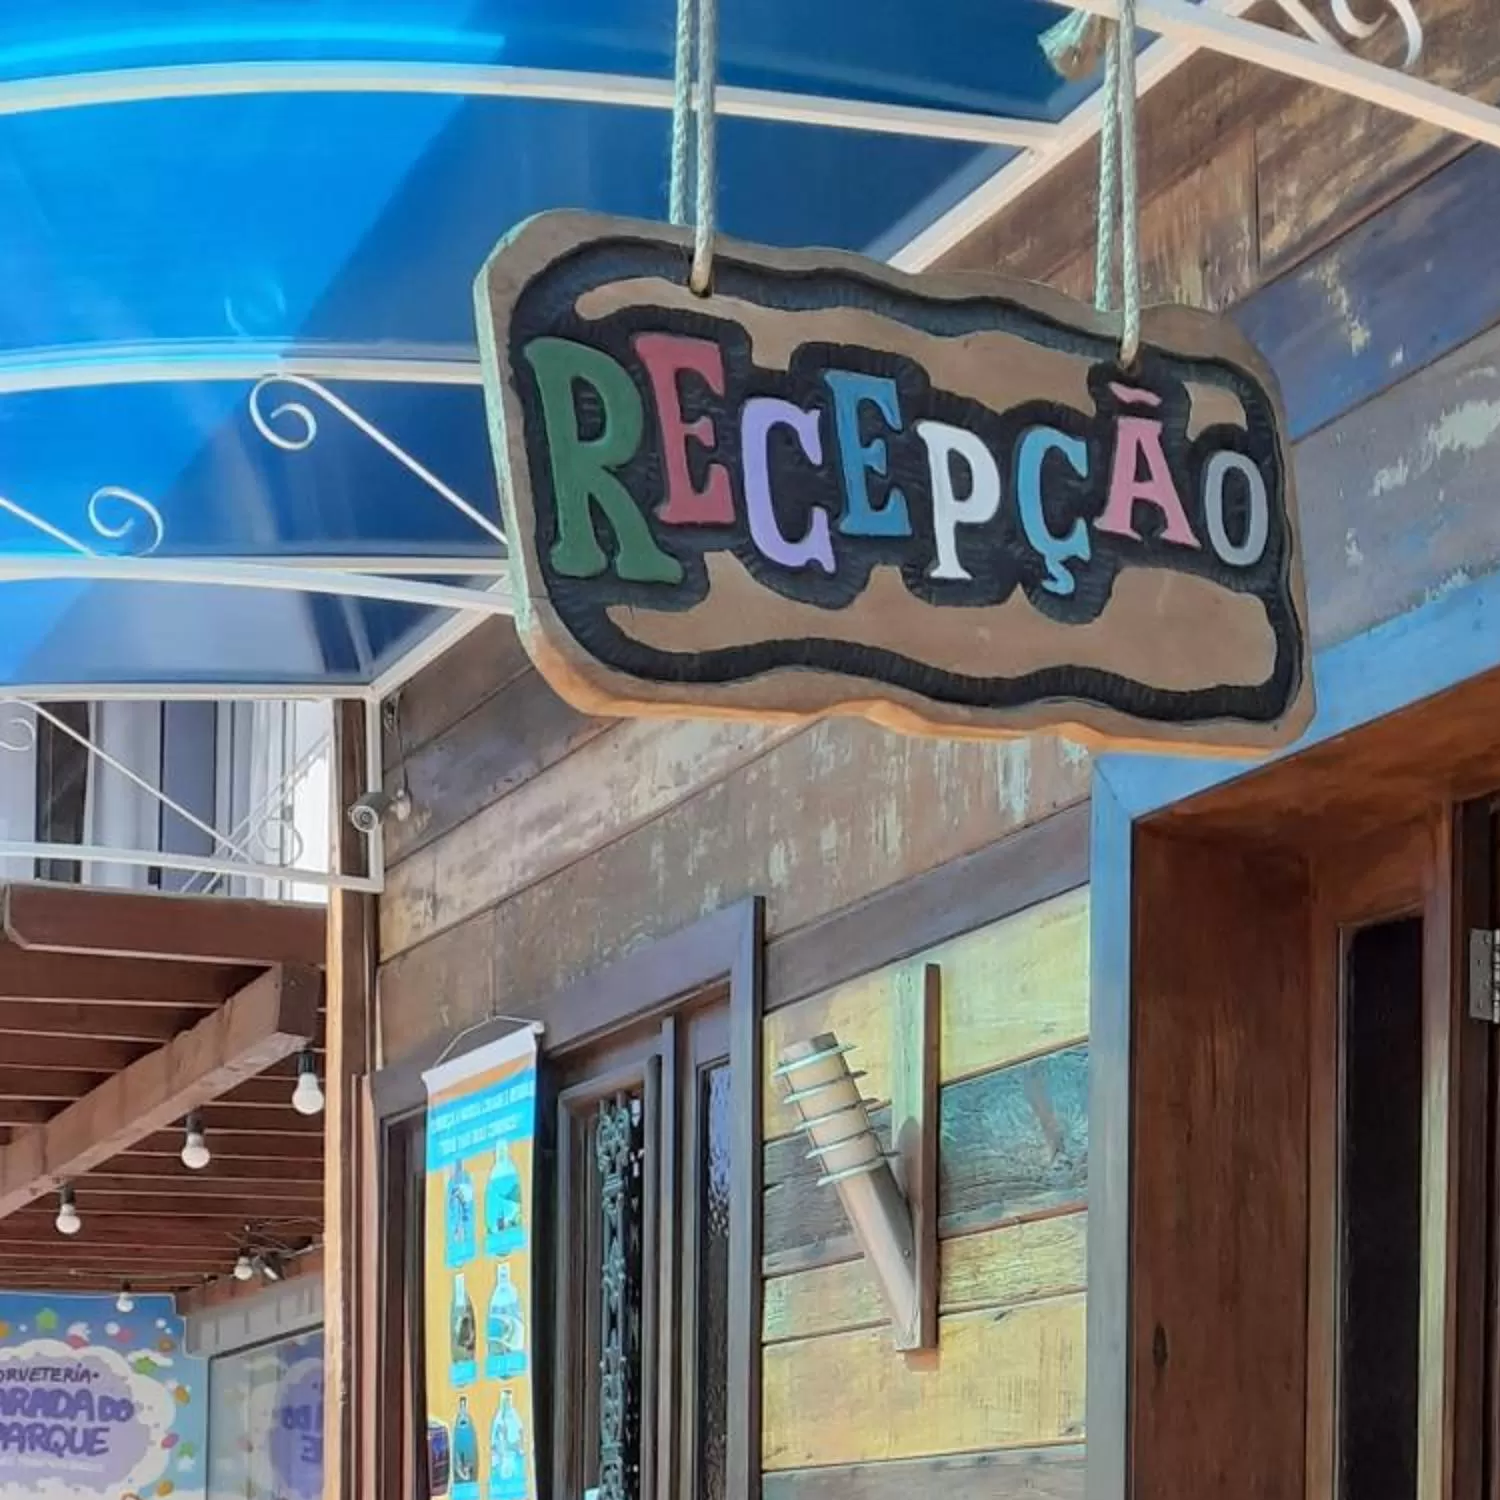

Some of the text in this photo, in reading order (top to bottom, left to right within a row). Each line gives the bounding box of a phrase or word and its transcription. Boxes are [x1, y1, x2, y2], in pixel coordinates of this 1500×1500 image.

[523, 331, 1270, 597] RECEPÇÃO
[0, 1387, 135, 1423] ARADA DO
